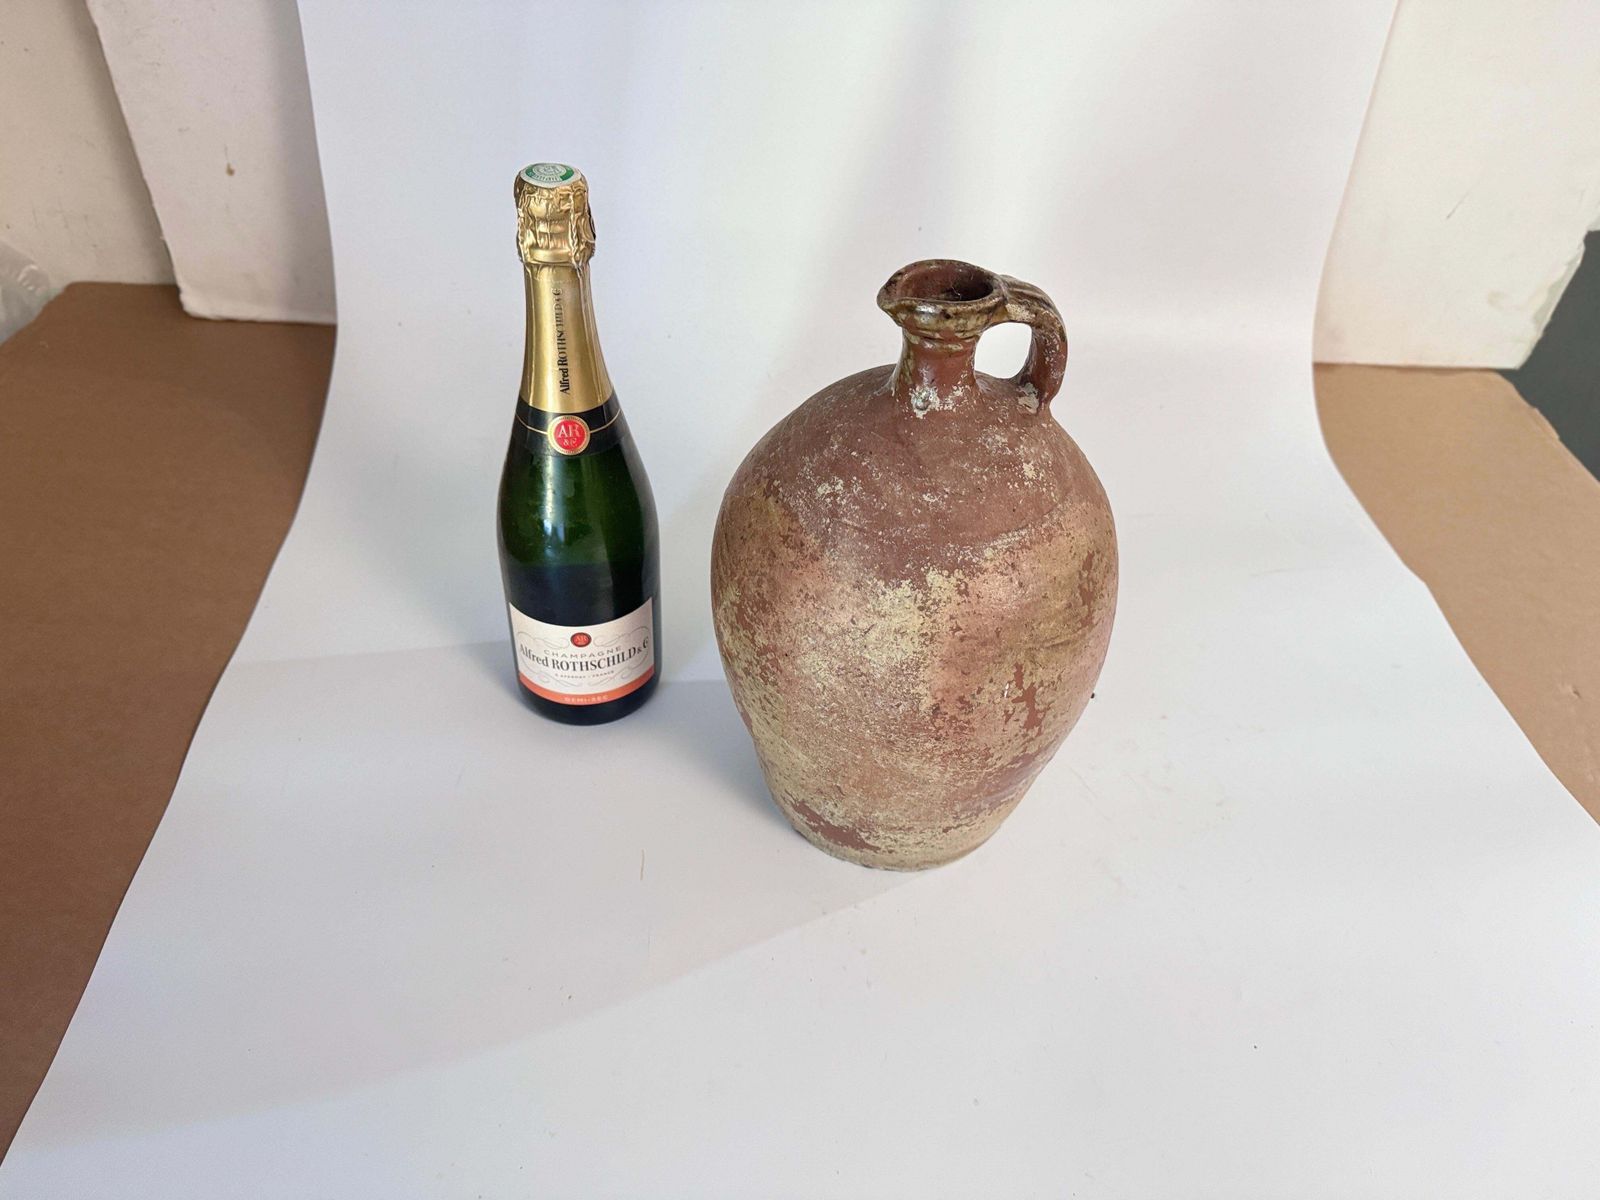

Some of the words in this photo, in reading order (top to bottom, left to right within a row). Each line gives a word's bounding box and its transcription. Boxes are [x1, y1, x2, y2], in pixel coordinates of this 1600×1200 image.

[554, 303, 569, 366] ROTHSCHILD
[559, 367, 571, 396] Alfred
[558, 424, 581, 438] AR
[520, 643, 550, 668] Alfred
[552, 646, 636, 672] ROTHSCHILD
[543, 646, 622, 659] CHAMPAGNE
